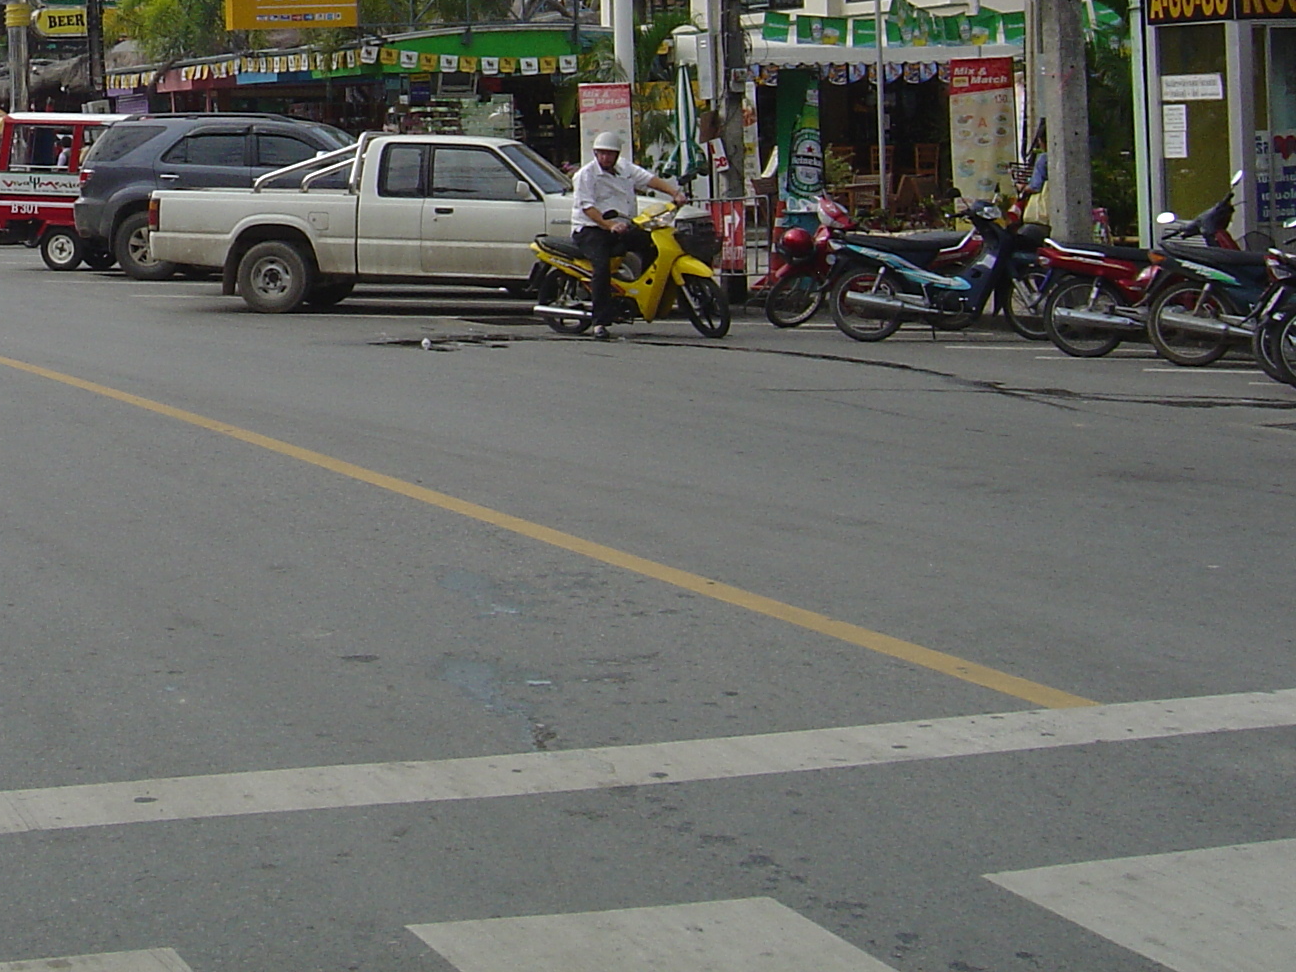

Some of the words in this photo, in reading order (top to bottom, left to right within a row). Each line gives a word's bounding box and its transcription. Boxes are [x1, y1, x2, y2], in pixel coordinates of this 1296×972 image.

[47, 13, 85, 29] BEER
[971, 75, 1007, 84] Match
[20, 203, 40, 215] 301
